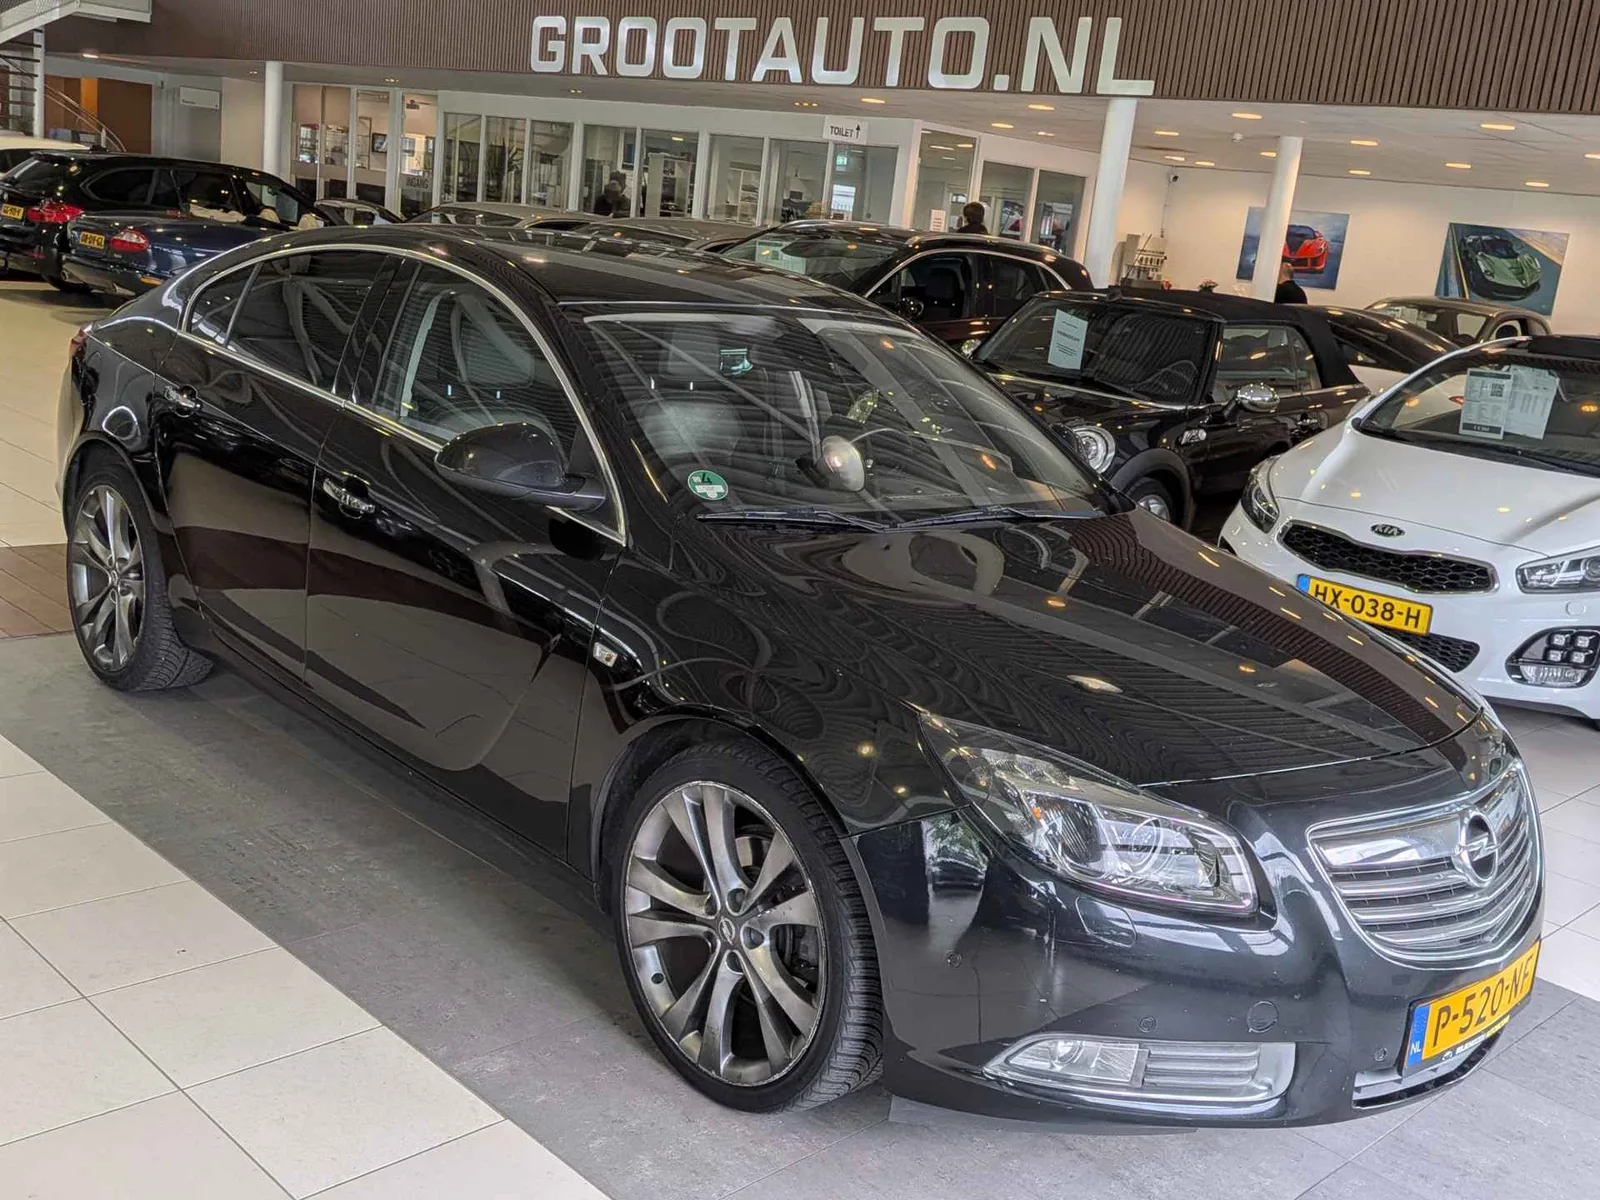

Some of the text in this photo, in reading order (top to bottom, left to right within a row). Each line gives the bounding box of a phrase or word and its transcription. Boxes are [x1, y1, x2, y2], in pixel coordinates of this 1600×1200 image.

[530, 15, 1155, 96] GROOTAUTO.NL
[830, 125, 854, 138] TOILET
[702, 472, 712, 484] 4
[1374, 523, 1399, 536] KIA
[1315, 584, 1421, 629] HX-038-H
[1432, 952, 1534, 1048] P-520-NF
[1410, 1040, 1421, 1056] NL
